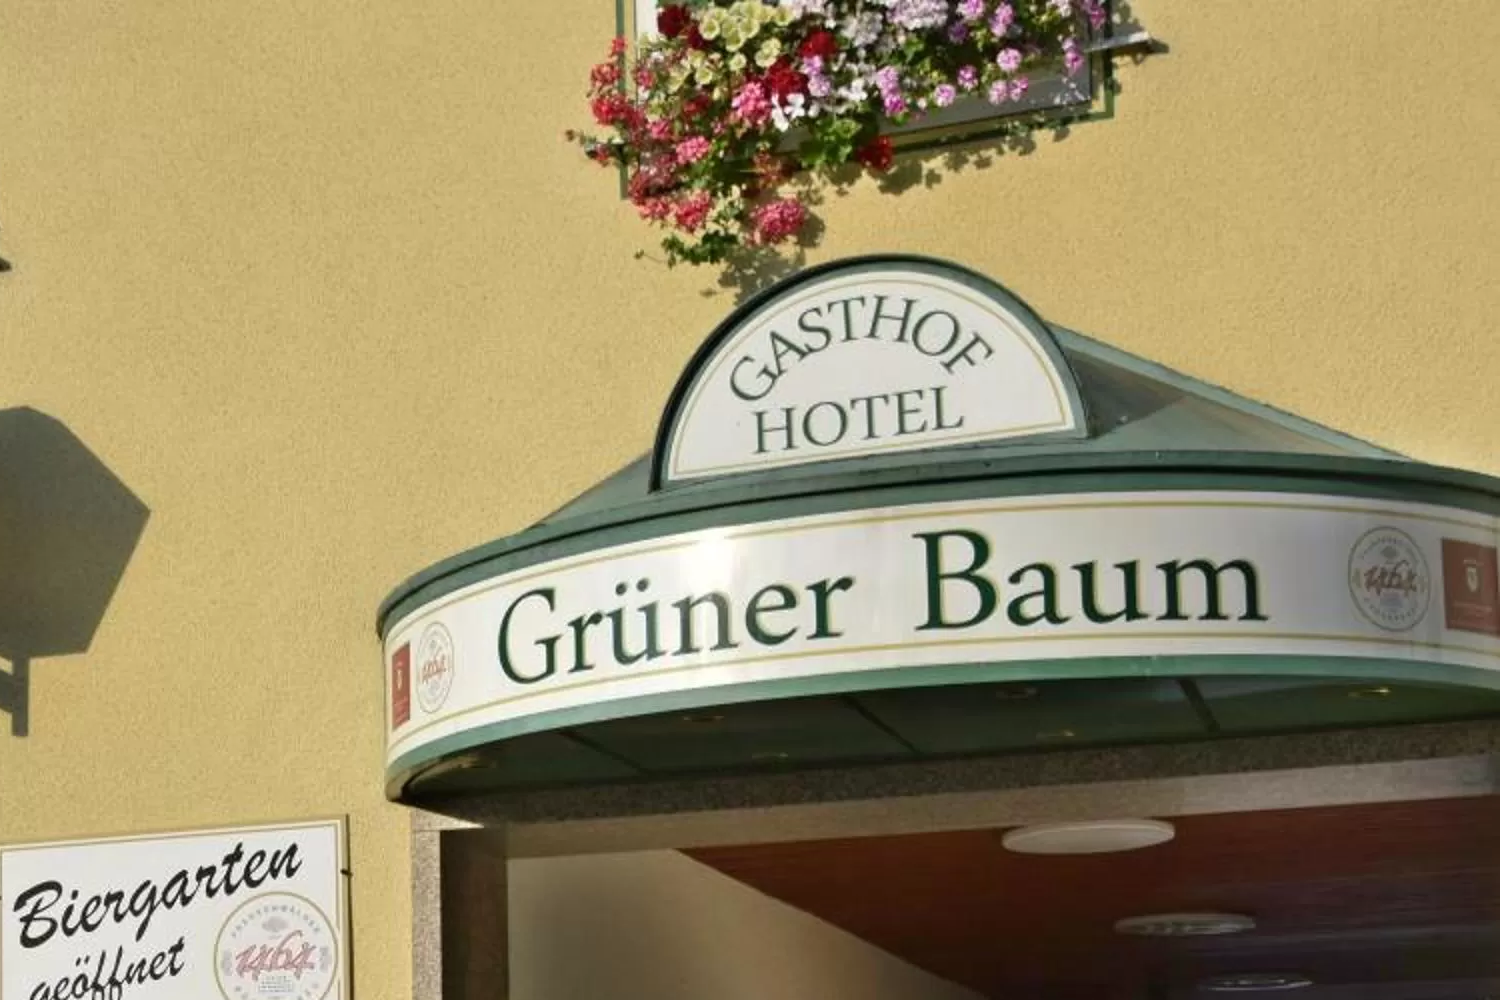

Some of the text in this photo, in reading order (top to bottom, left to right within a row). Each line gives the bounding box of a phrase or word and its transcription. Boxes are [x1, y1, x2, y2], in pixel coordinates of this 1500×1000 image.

[729, 295, 995, 402] GASTHOF
[752, 386, 965, 455] HOTEL
[498, 528, 1269, 685] Grüner Baum
[13, 842, 303, 949] Biergarten
